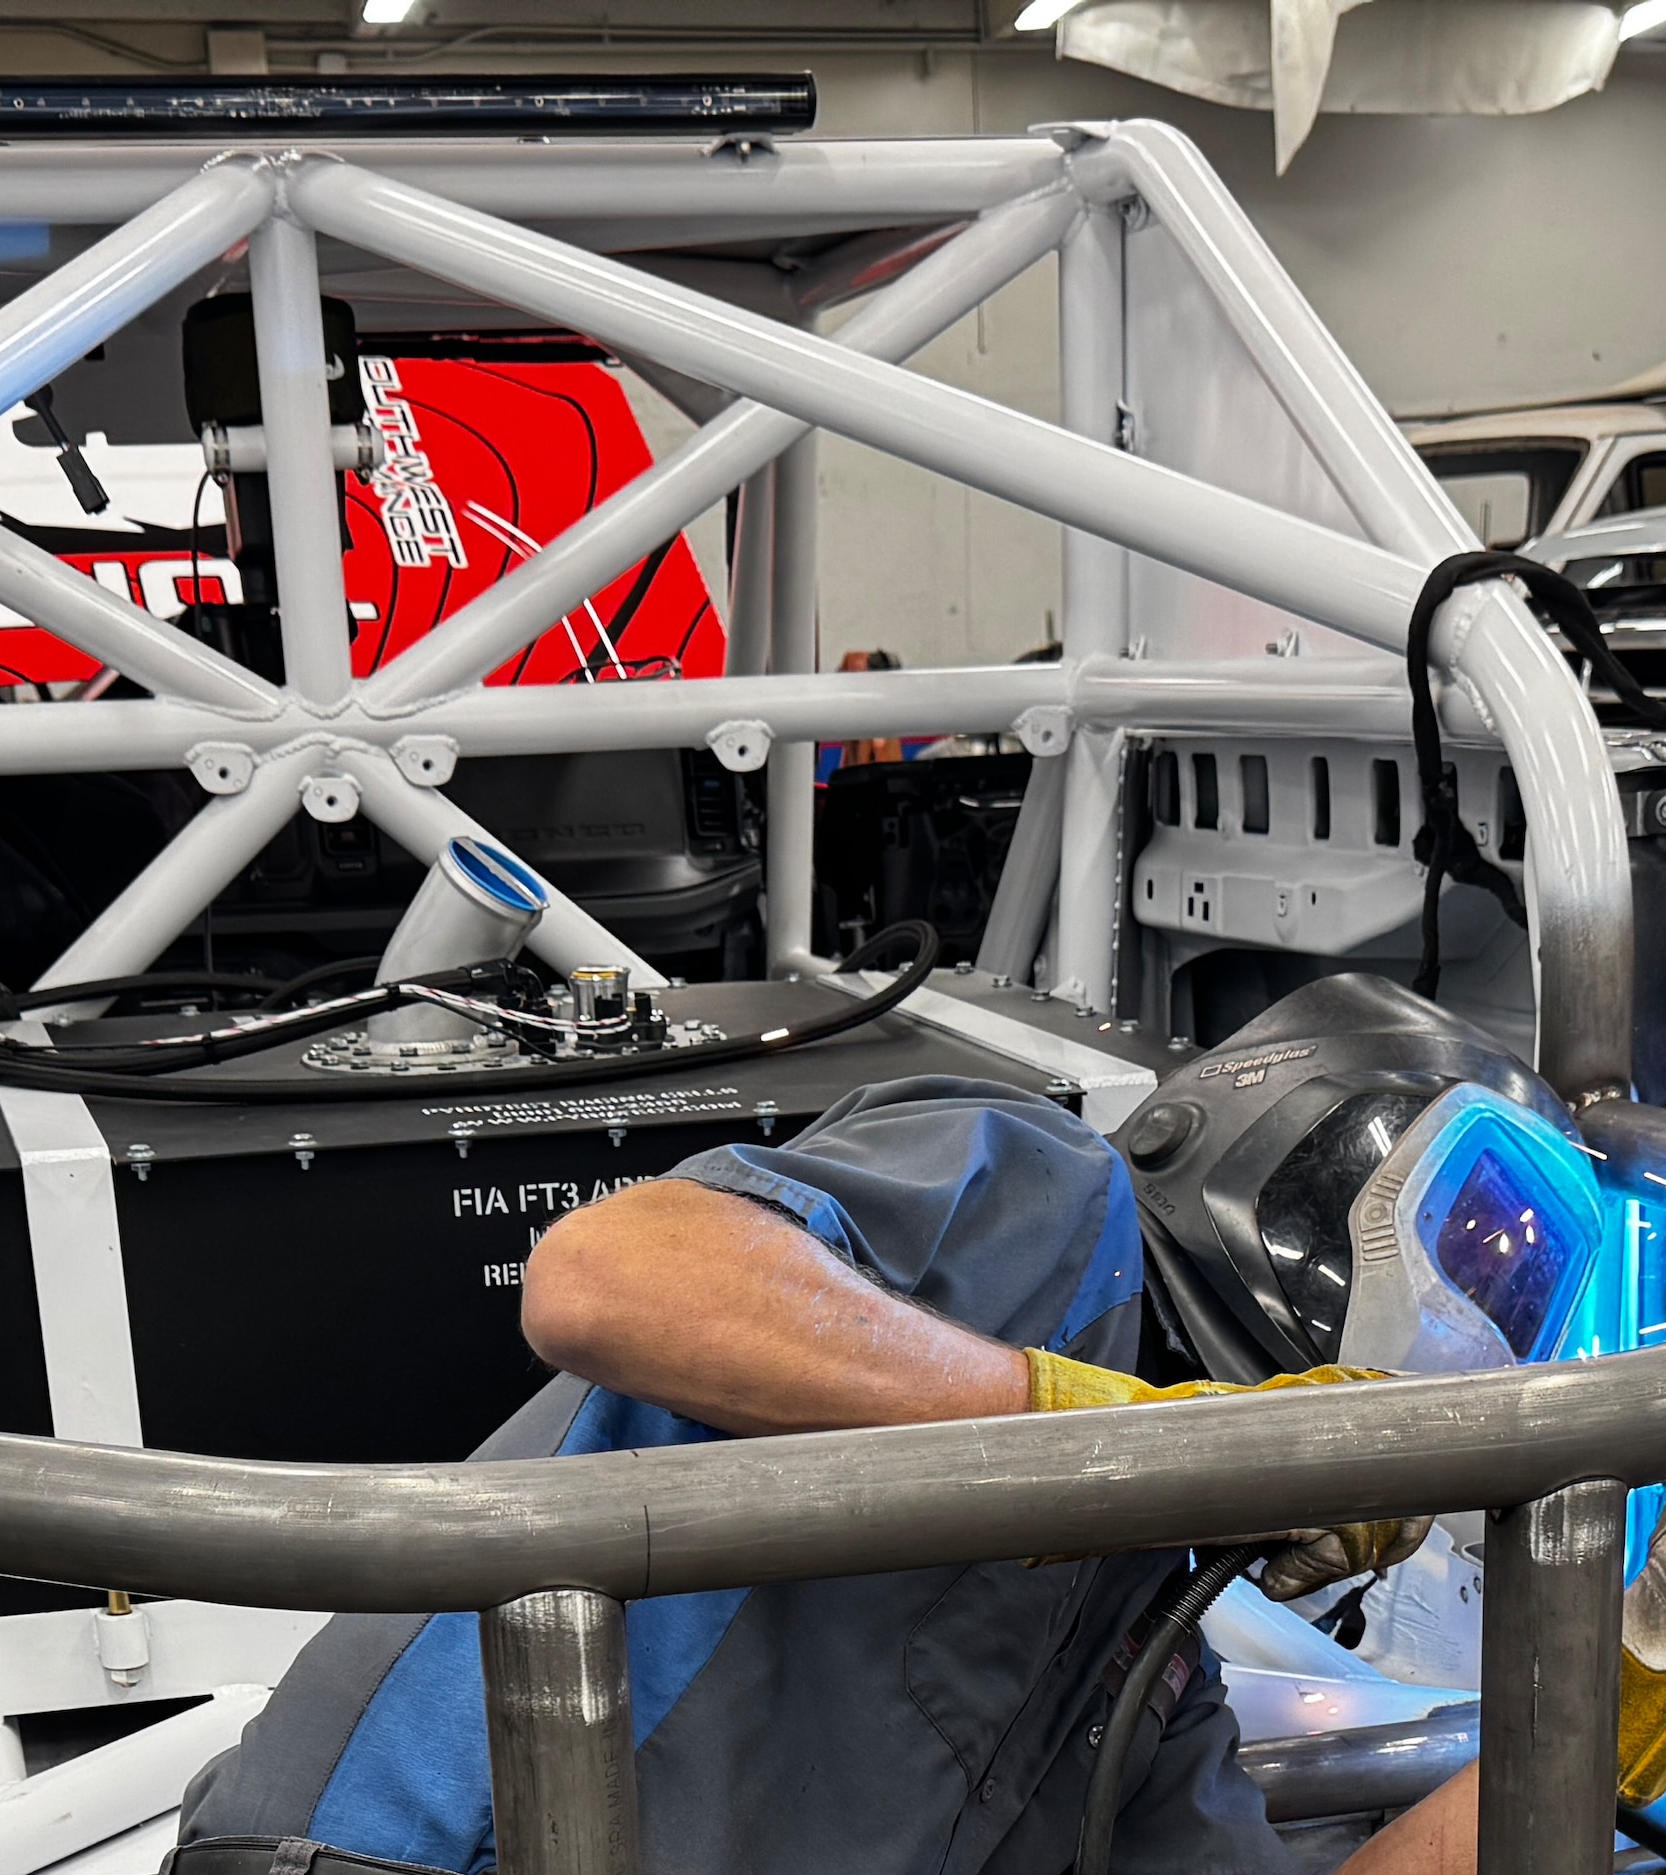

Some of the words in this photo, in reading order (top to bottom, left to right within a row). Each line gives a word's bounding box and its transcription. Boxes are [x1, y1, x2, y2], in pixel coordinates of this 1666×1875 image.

[1221, 1045, 1311, 1074] Speedglas
[1235, 1069, 1266, 1089] 3M
[453, 1185, 510, 1218] FIA
[519, 1181, 580, 1213] FT3
